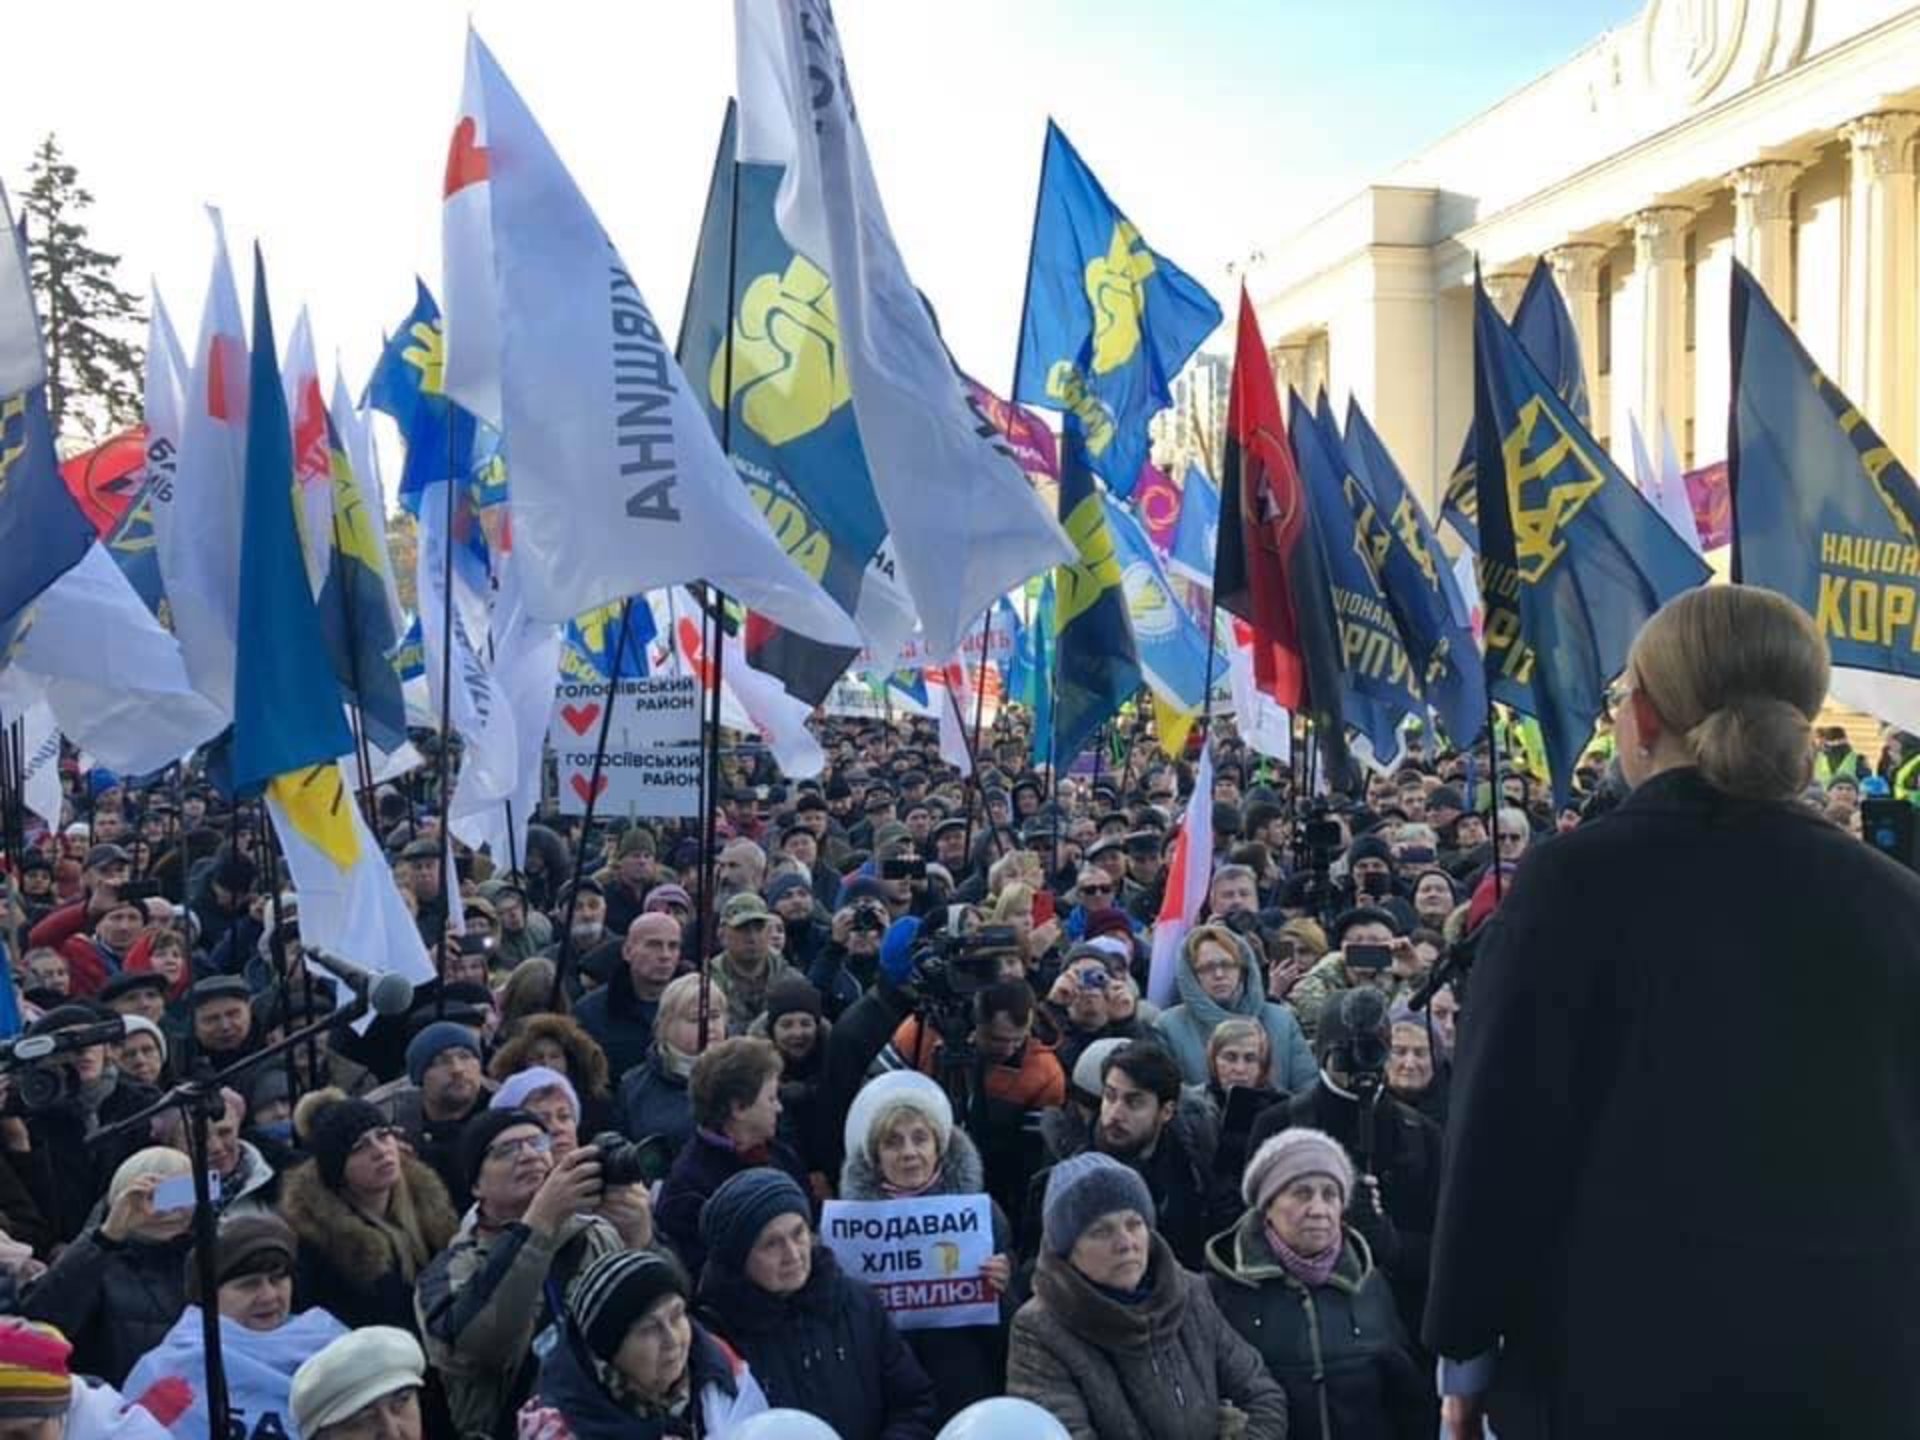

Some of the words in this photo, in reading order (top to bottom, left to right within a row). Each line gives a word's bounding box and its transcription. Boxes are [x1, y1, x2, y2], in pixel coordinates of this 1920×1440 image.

[1821, 532, 1920, 574] НАЦІОН
[1814, 573, 1920, 652] КОР
[636, 696, 694, 711] РАЙОН
[643, 772, 701, 787] РАЙОН
[832, 1207, 978, 1242] ПРОДАВАЙ
[862, 1249, 923, 1273] ХЛІБ
